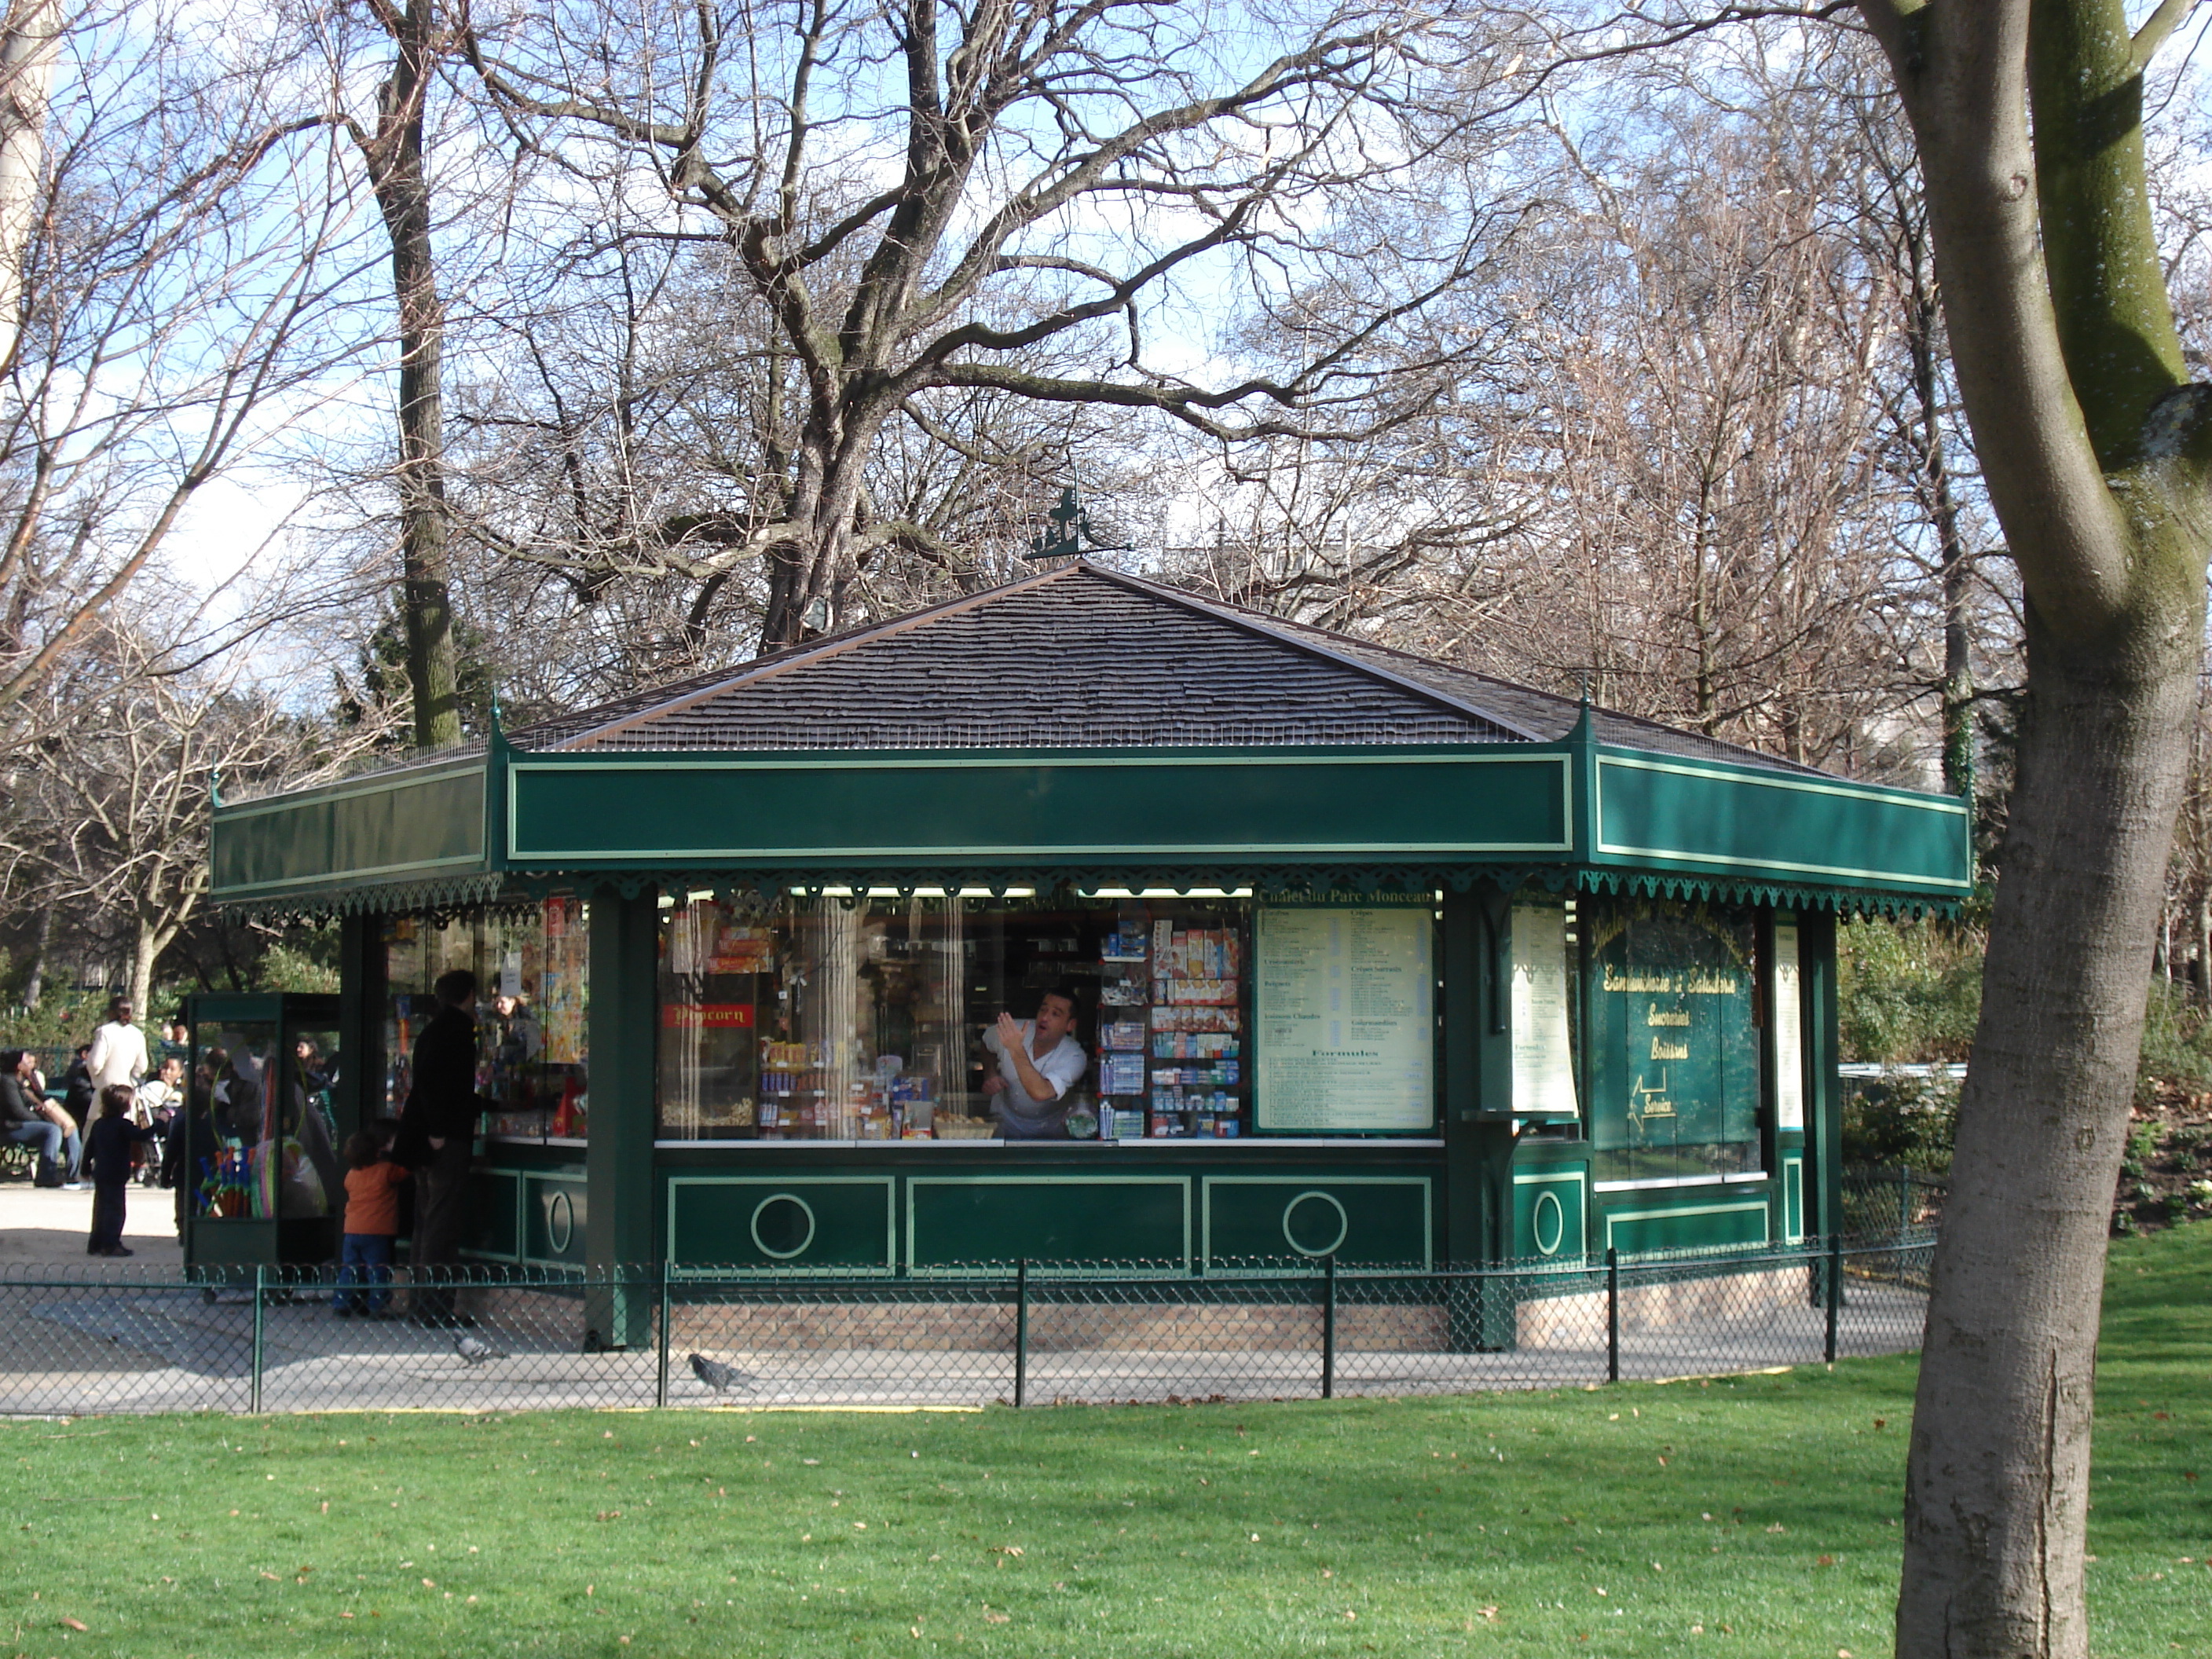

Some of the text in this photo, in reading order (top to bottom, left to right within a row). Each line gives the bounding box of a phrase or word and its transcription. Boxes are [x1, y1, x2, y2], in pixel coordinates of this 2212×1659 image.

[1330, 888, 1363, 903] Parc
[1367, 888, 1430, 903] Monceau
[672, 1006, 746, 1025] Popcorn
